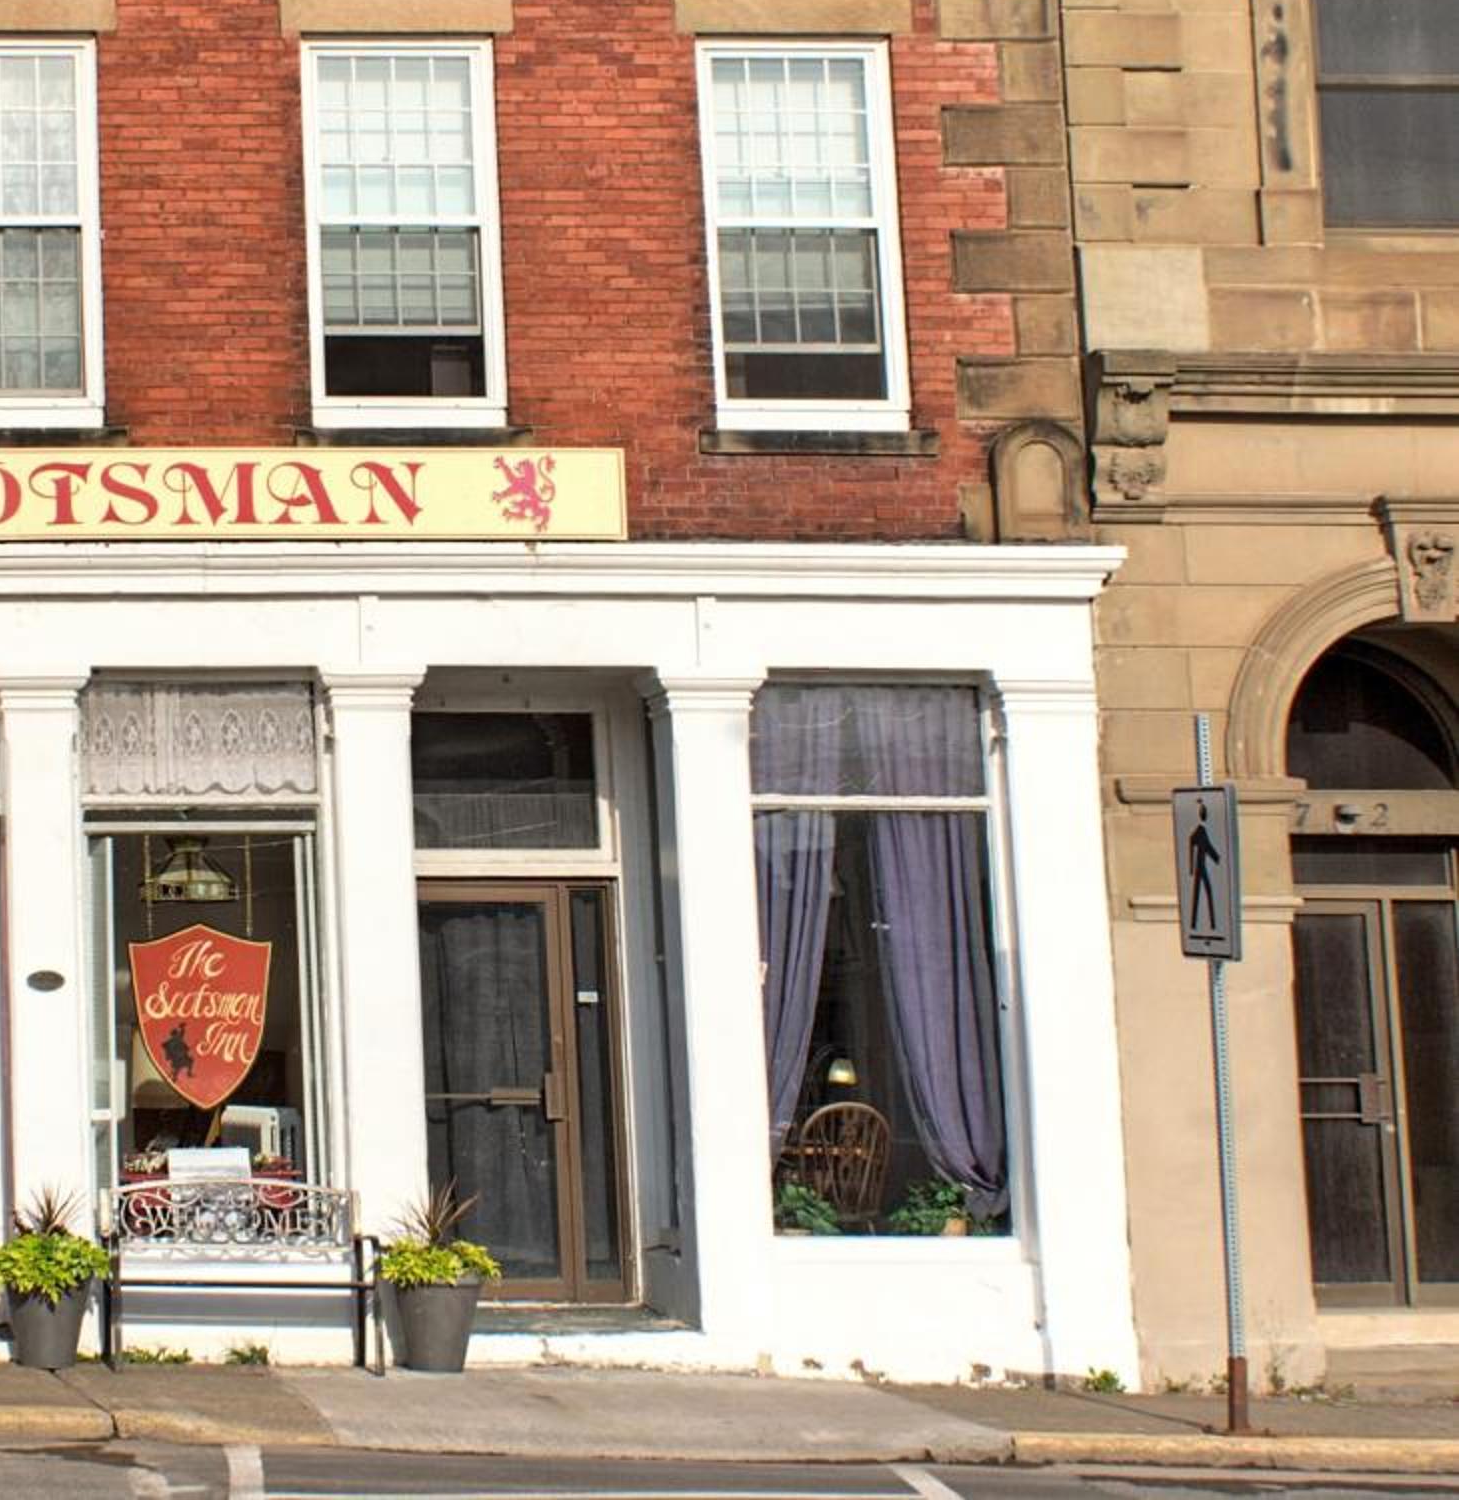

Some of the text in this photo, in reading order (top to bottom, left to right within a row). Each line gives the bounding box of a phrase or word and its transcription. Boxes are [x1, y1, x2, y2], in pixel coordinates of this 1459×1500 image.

[167, 940, 227, 978] The
[144, 981, 262, 1025] Scotsman
[196, 1021, 252, 1063] Inn
[143, 1203, 320, 1235] WELCOME
